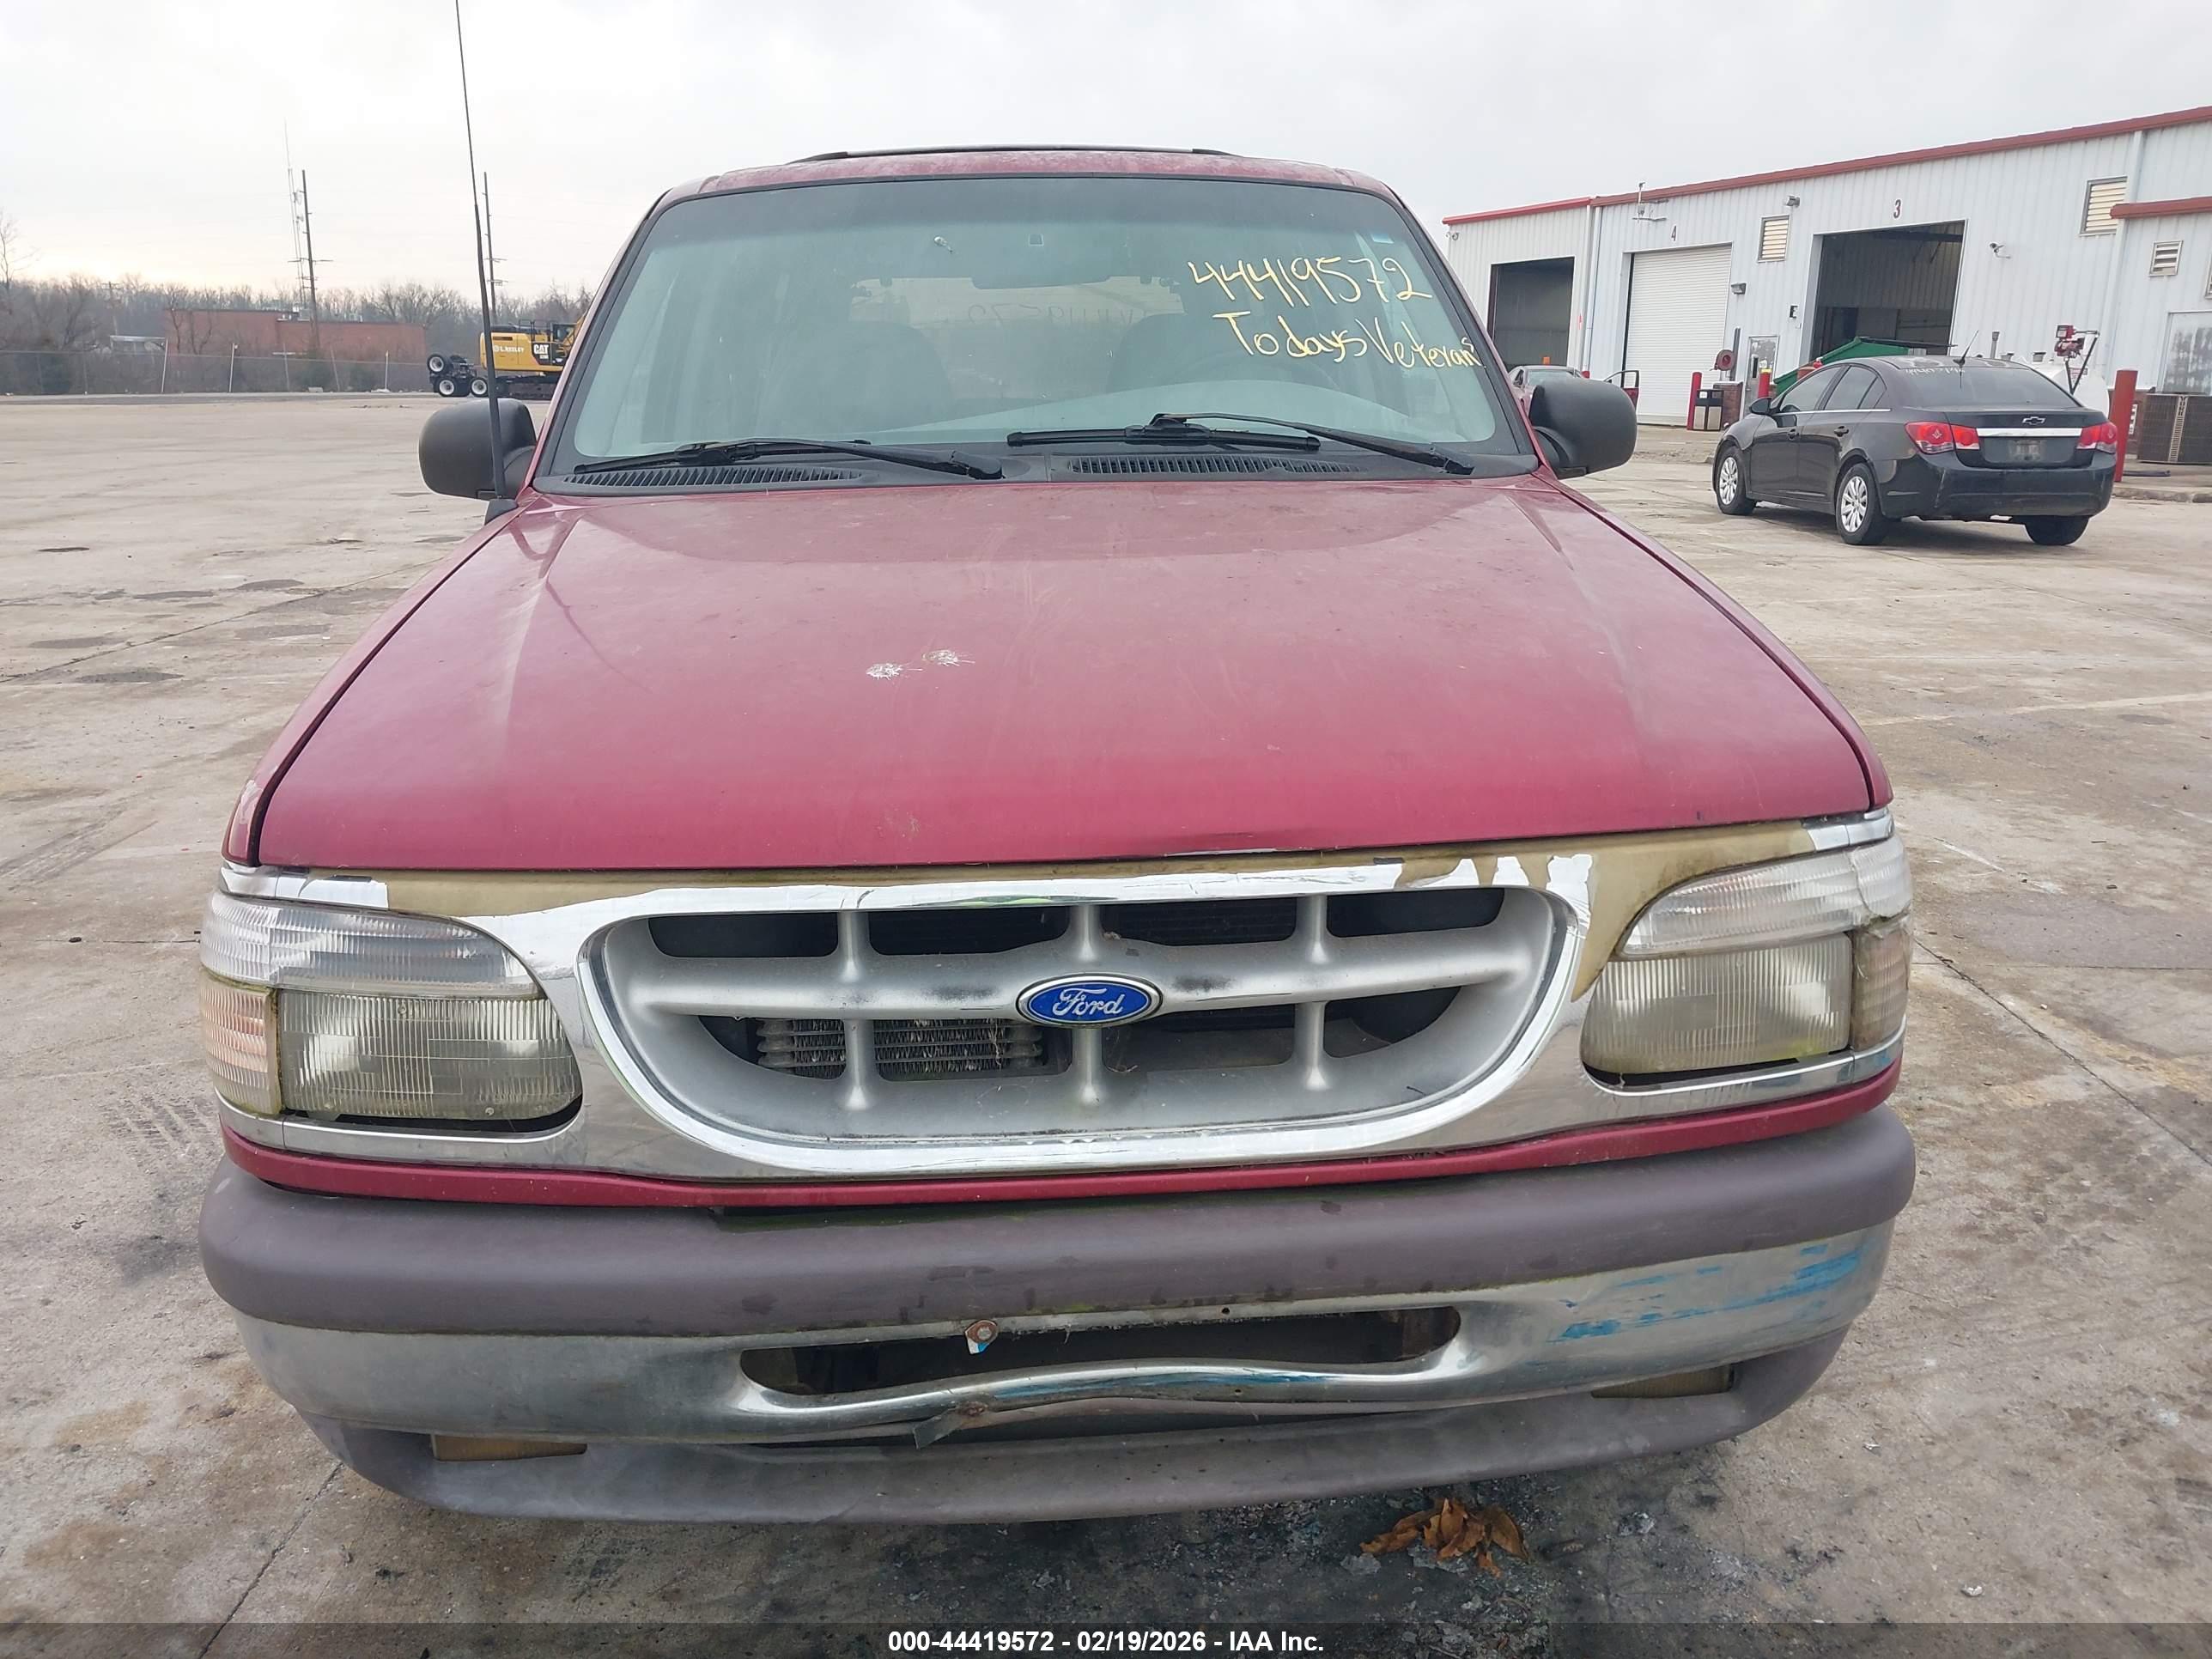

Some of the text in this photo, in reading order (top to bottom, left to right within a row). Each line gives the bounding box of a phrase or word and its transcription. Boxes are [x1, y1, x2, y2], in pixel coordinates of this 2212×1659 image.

[1893, 199, 1902, 219] 3
[1671, 226, 1677, 241] 4
[1188, 257, 1432, 307] 44419572
[533, 343, 550, 355] CAT
[1052, 988, 1125, 1016] Ford
